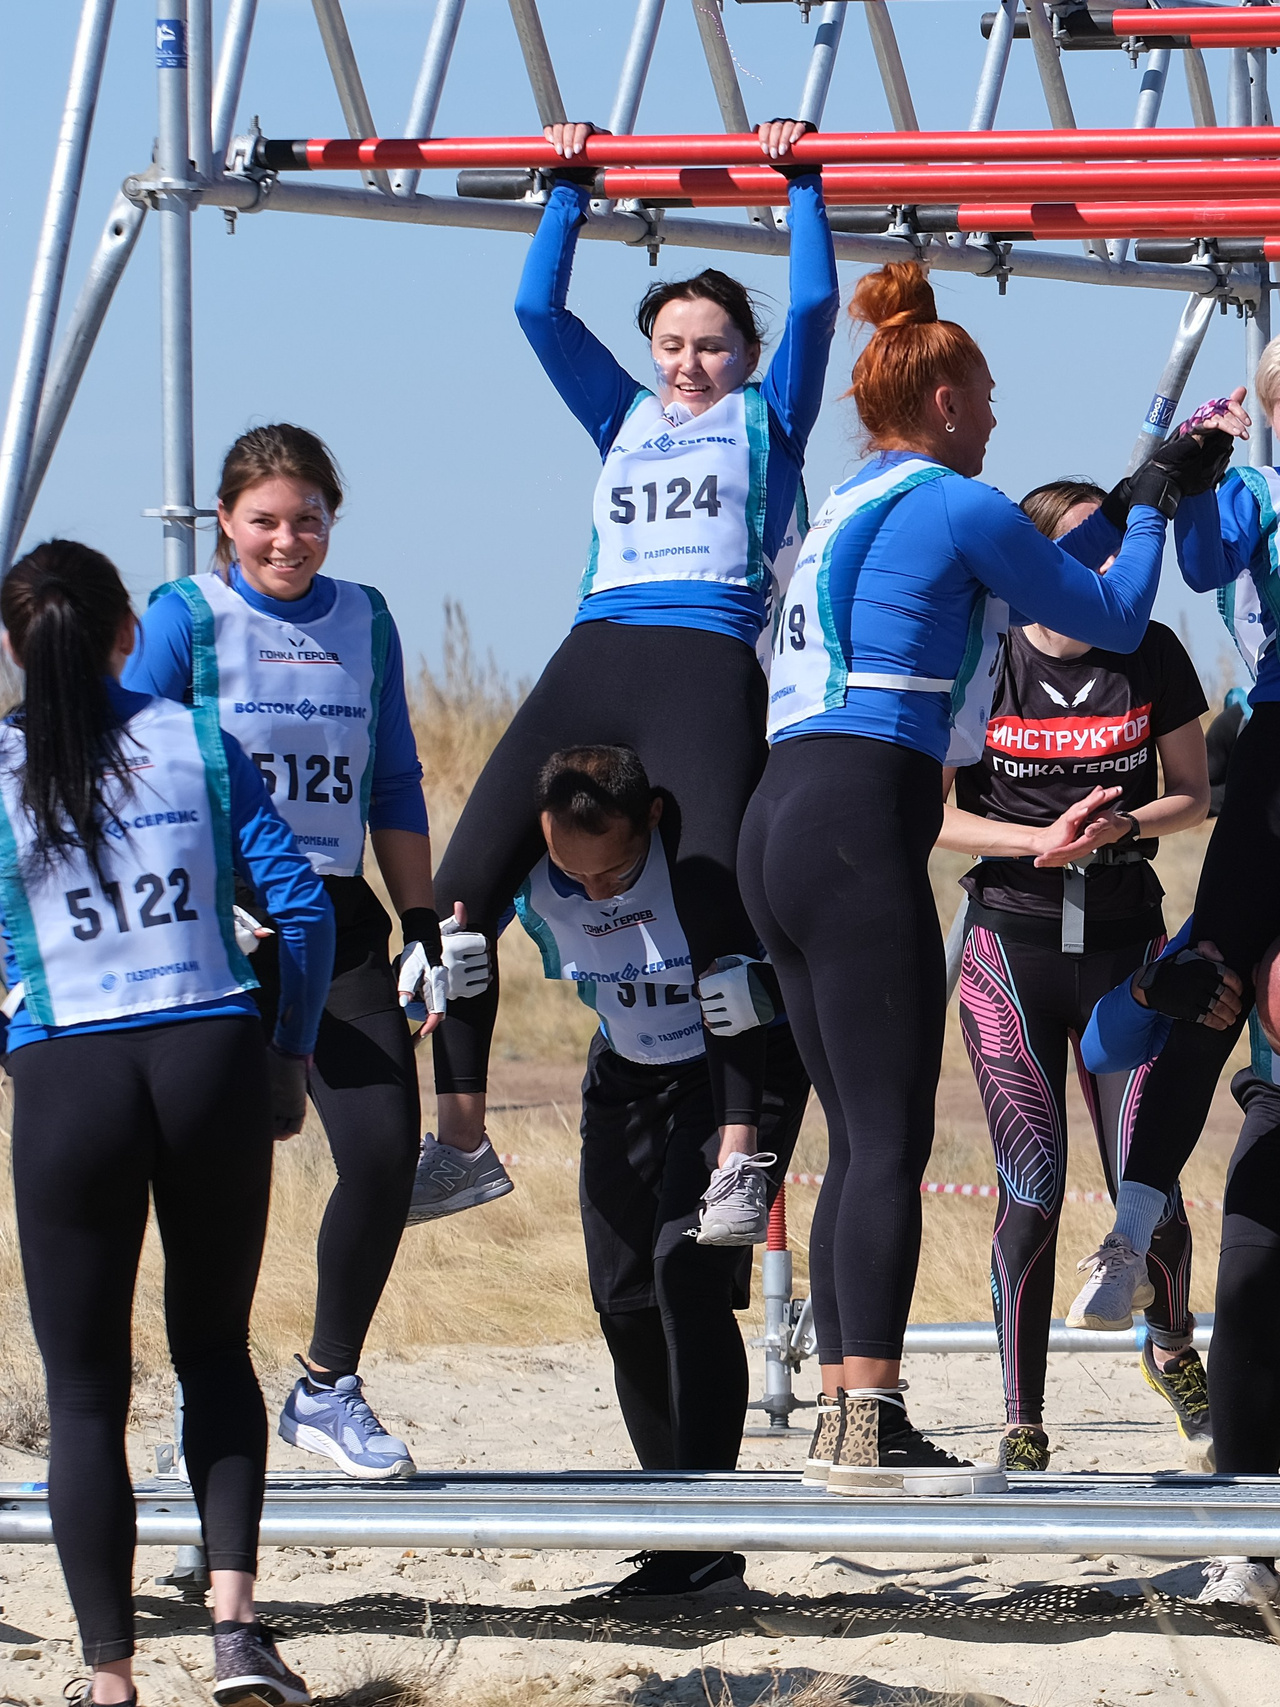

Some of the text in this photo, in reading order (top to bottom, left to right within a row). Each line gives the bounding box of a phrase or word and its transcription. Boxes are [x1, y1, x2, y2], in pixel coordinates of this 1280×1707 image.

[610, 475, 722, 525] 5124
[644, 545, 710, 560] ГАЗПРОМБАНК
[260, 650, 339, 661] ГОНКА ГЕРОЕВ
[234, 702, 296, 715] ВОСТОК
[992, 714, 1149, 752] ИНСТРУКТОР
[992, 747, 1148, 779] ГОНКА ГЕРОЕВ
[252, 752, 354, 805] 5125
[134, 810, 199, 829] СЕРВИС
[65, 867, 199, 942] 5122
[582, 909, 654, 934] ГОНКА ГЕРОЕВ
[571, 970, 621, 983] ВОСТОК
